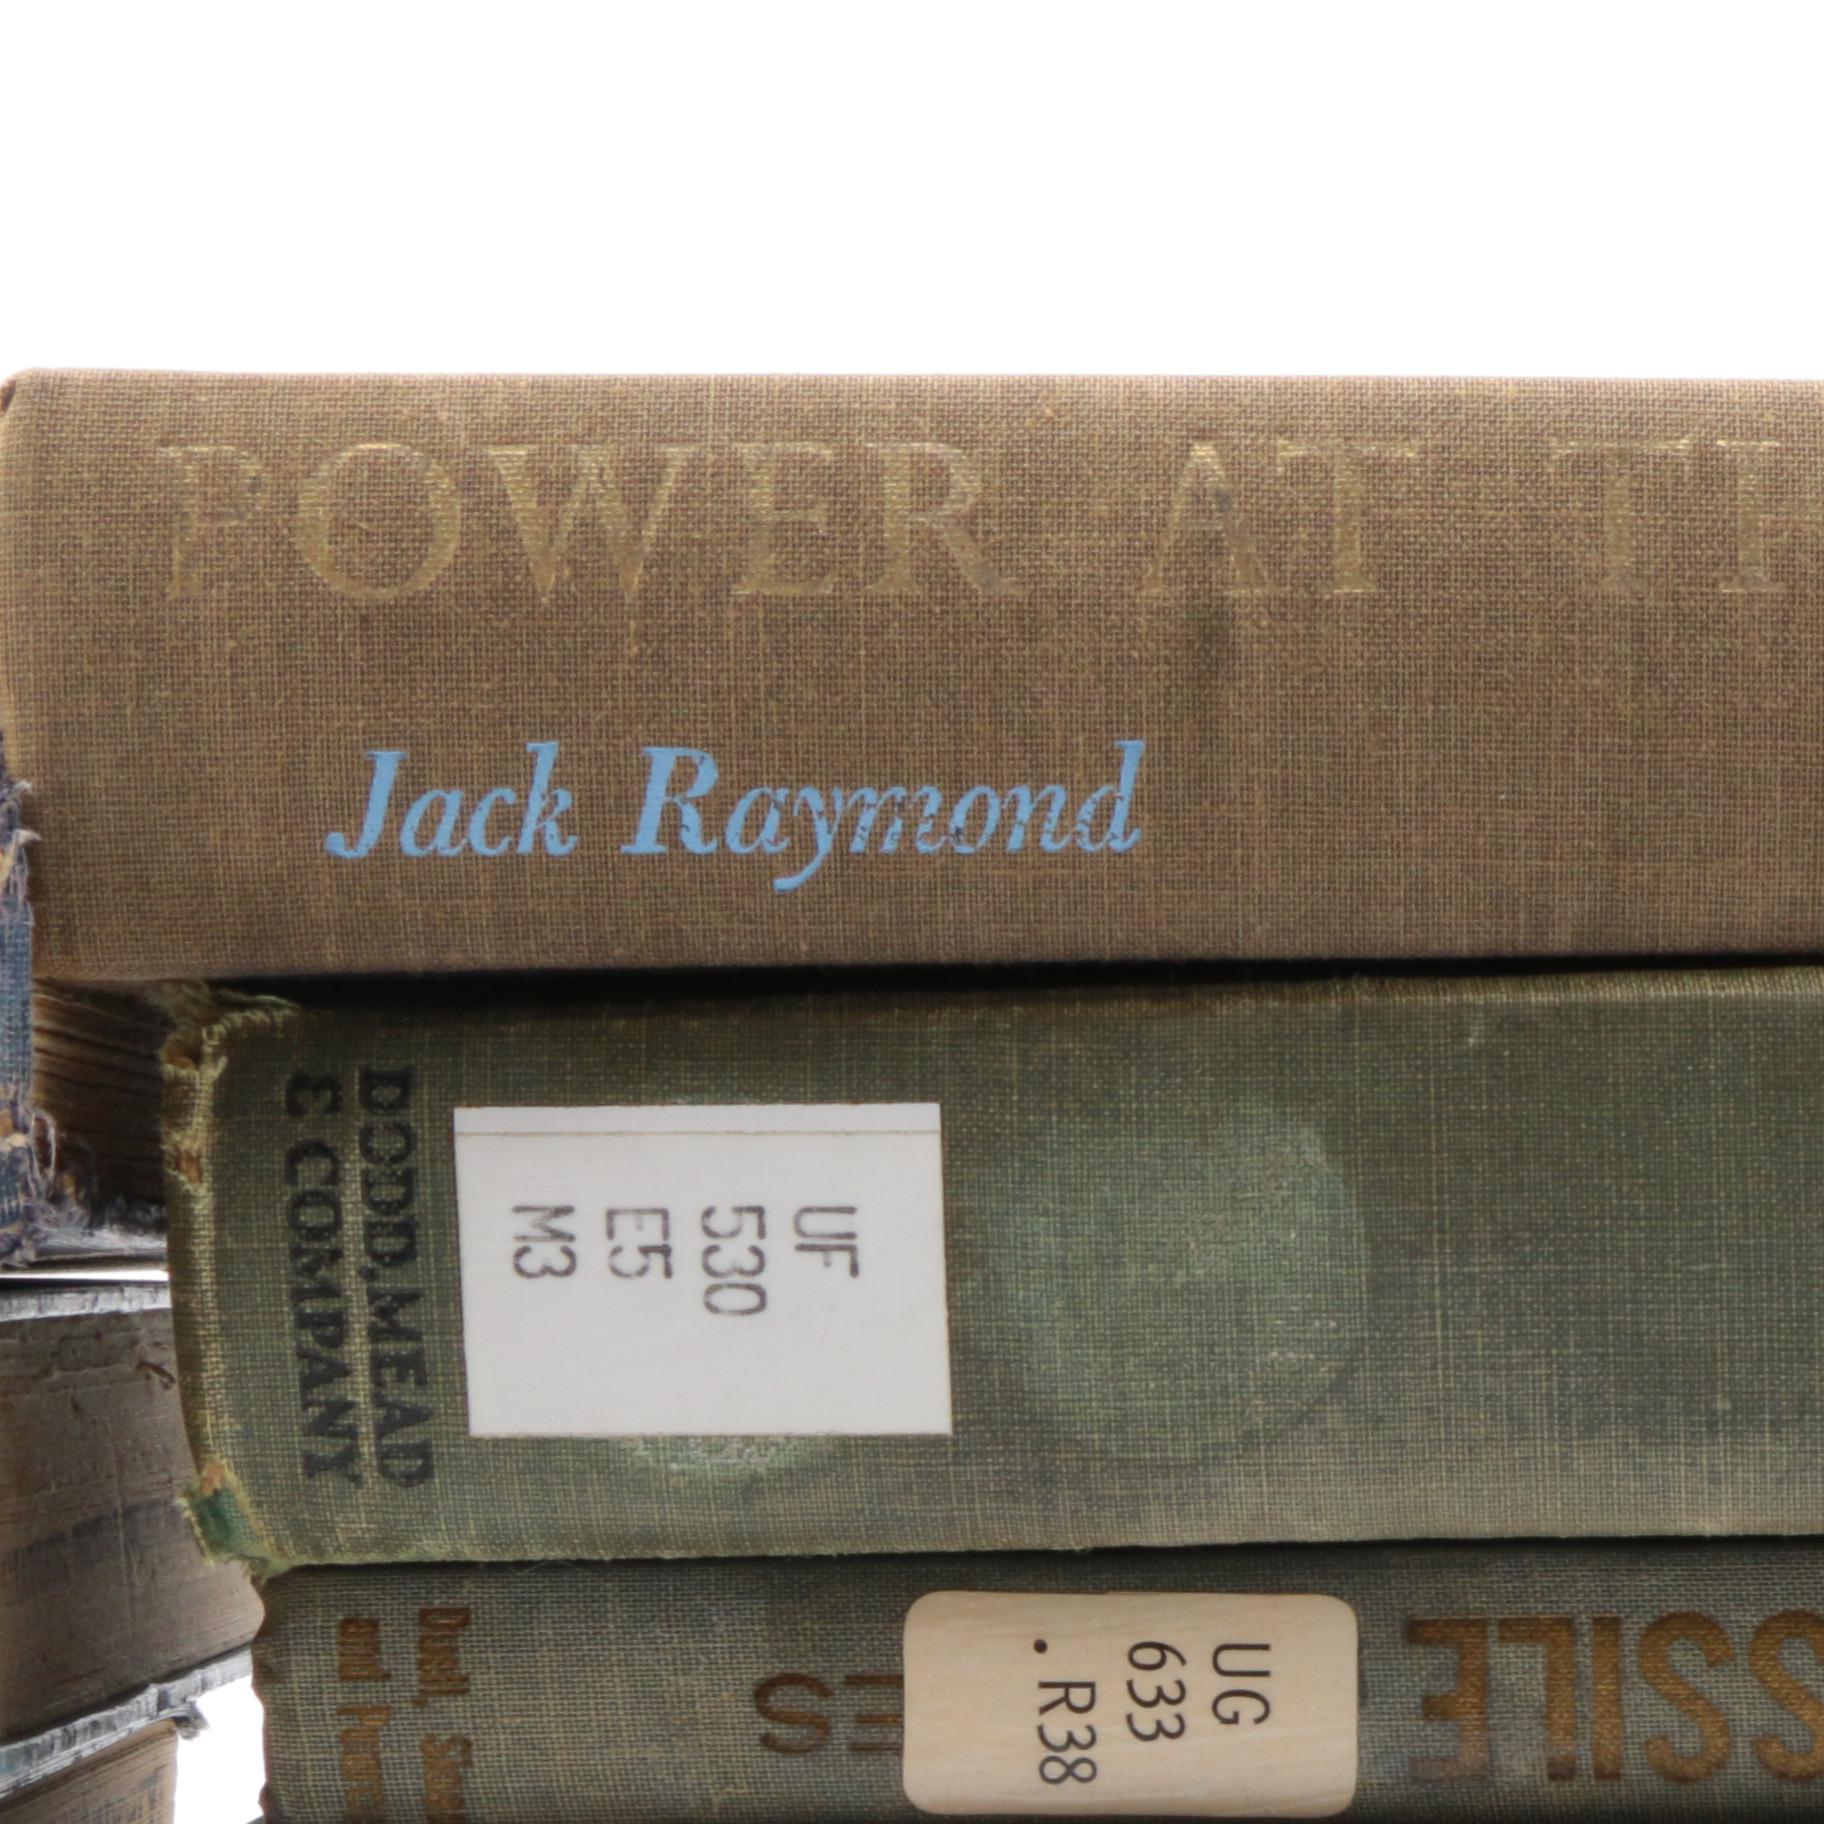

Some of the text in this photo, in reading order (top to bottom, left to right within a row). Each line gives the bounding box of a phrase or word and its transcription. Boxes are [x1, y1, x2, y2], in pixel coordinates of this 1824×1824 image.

[155, 441, 1020, 602] POWER
[1138, 438, 1421, 596] AT
[325, 740, 1146, 891] Jack Raymond
[511, 1203, 577, 1281] M3
[606, 1207, 673, 1281] E5
[701, 1204, 767, 1317] 530
[794, 1204, 859, 1279] UF
[284, 1139, 364, 1487] COMPANY
[1033, 1637, 1098, 1785] .R38
[1127, 1640, 1187, 1742] 633
[1212, 1642, 1273, 1726] UG
